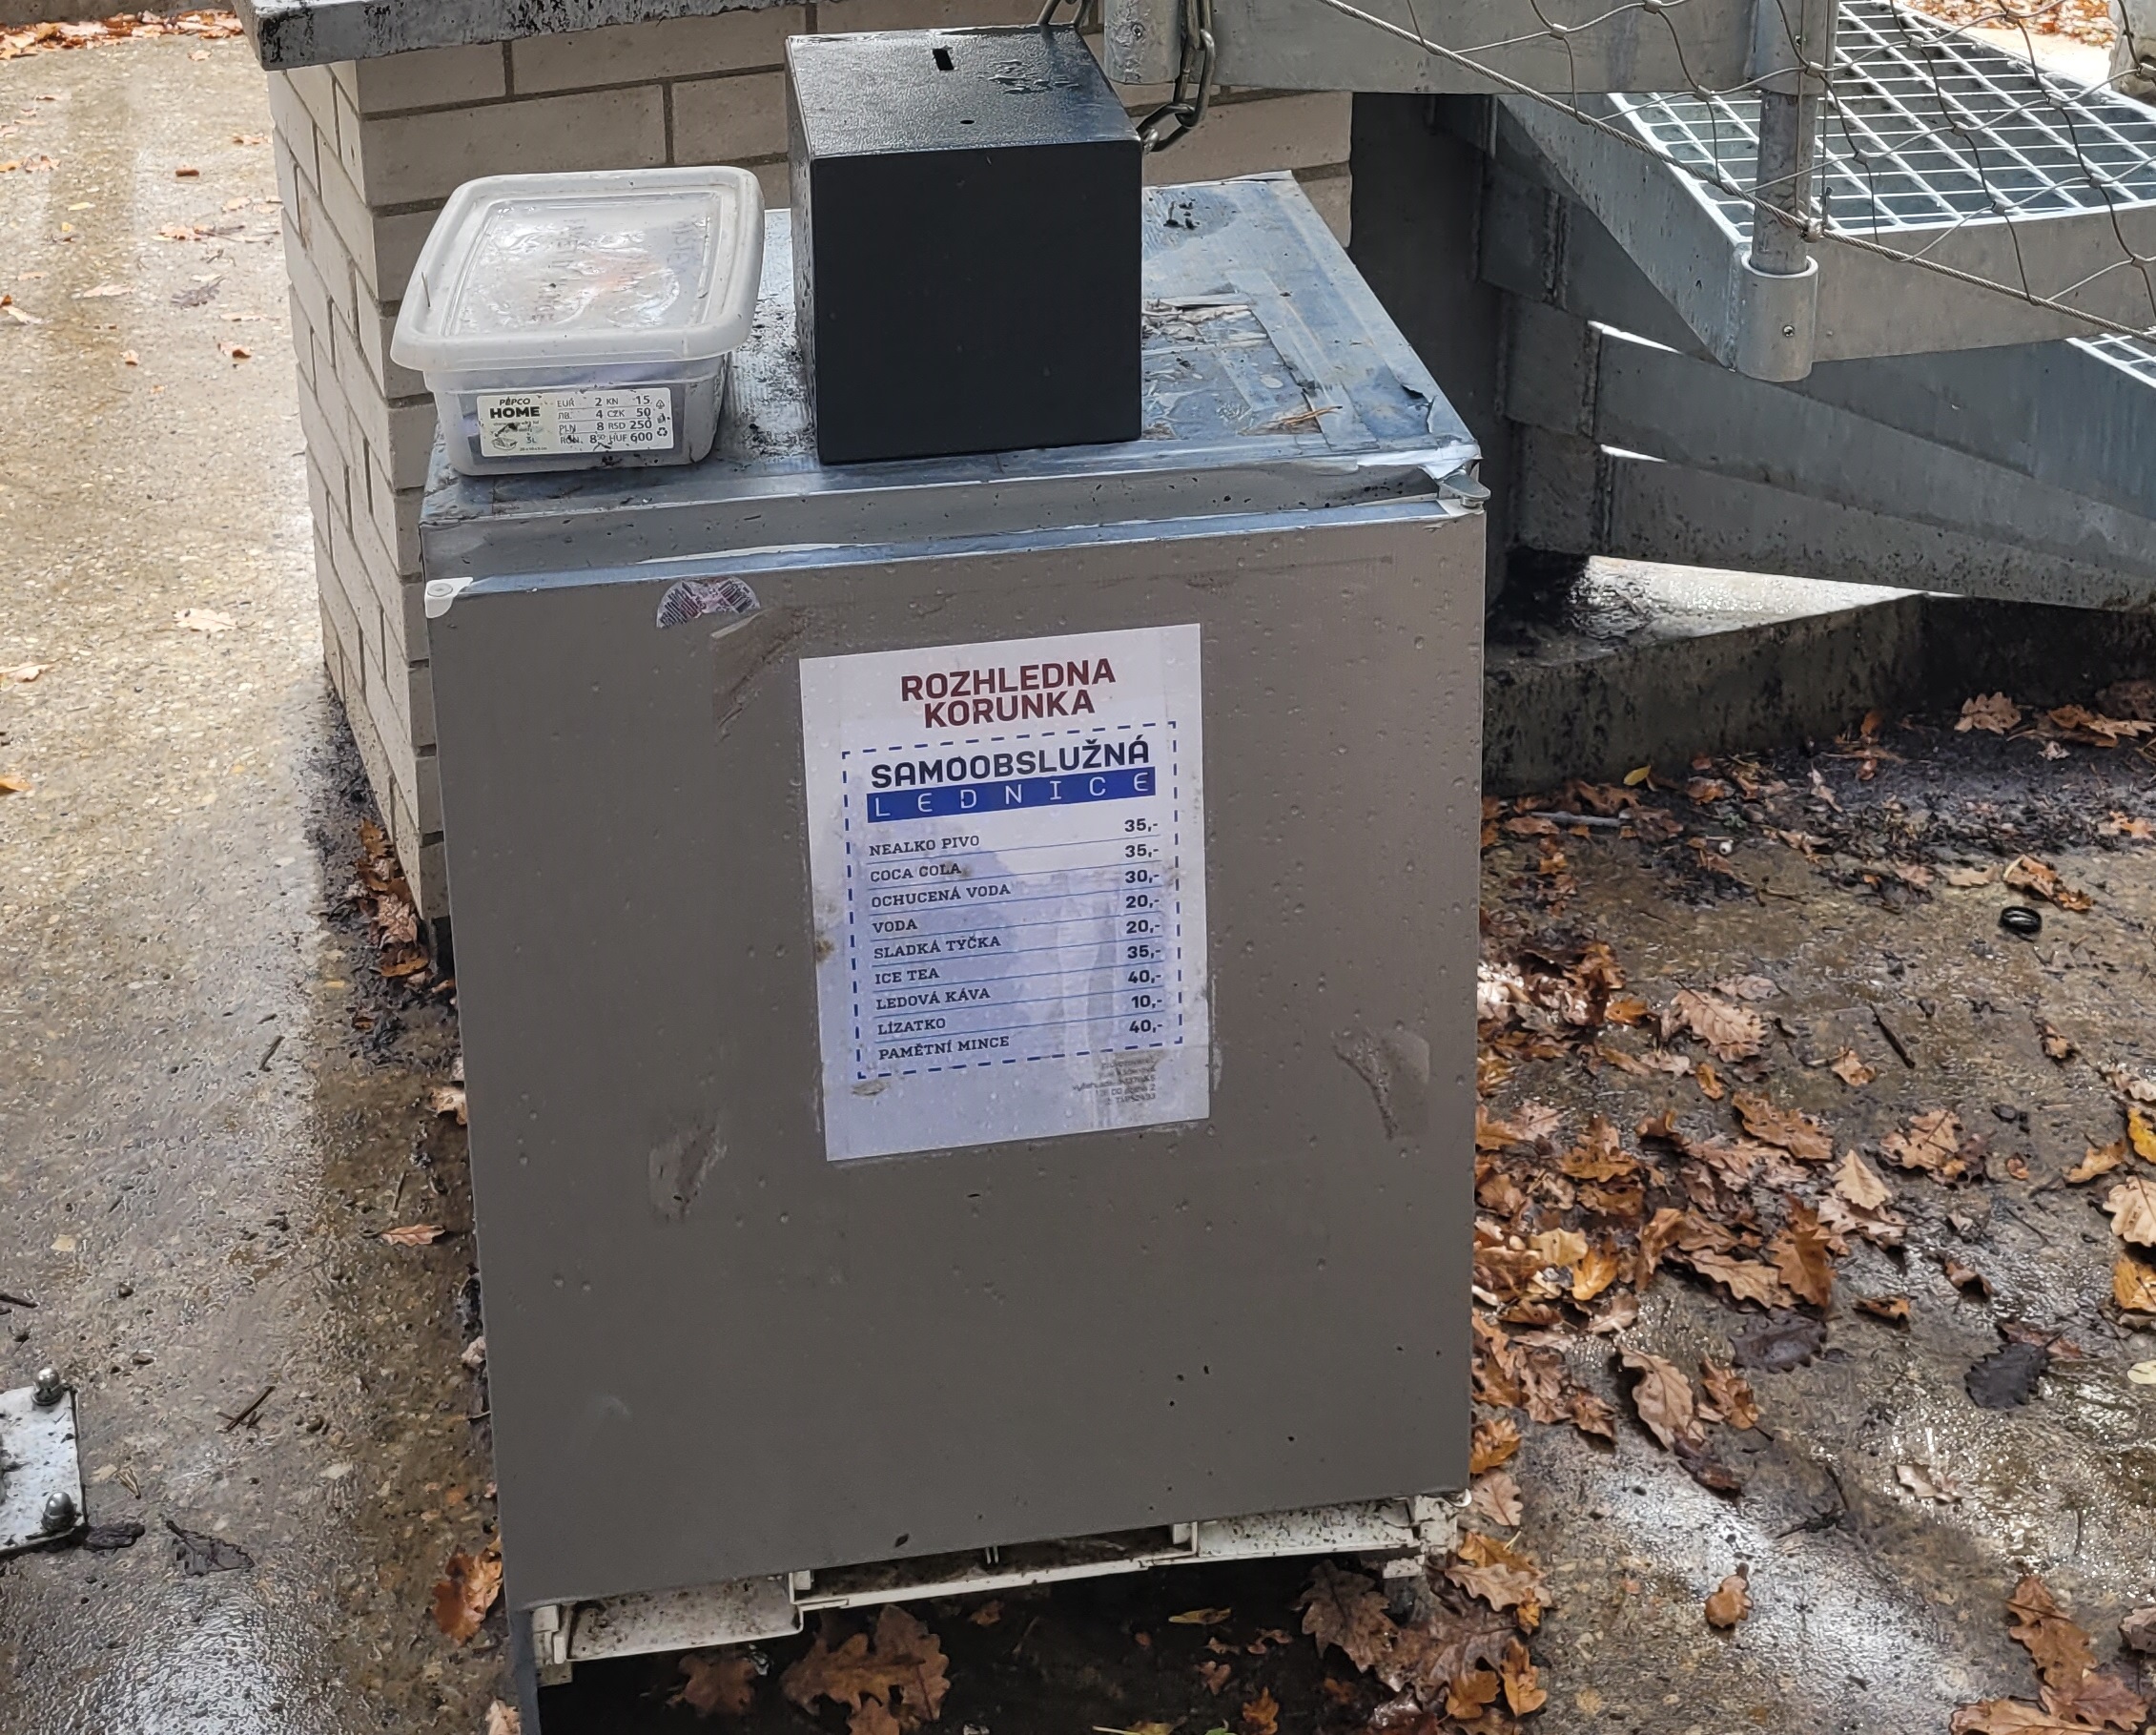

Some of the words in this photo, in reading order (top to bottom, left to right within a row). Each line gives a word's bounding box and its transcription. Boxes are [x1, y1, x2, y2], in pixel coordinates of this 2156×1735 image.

[489, 406, 541, 419] HOME
[500, 397, 531, 406] PEPCO
[557, 399, 575, 407] EUR
[595, 397, 603, 407] 2
[596, 409, 604, 419] 4
[607, 409, 626, 418] CZK
[636, 407, 651, 417] 50
[636, 395, 650, 404] 15
[559, 424, 576, 433] PLN
[597, 422, 605, 431] 8
[608, 422, 626, 430] RSD
[629, 420, 652, 429] 250
[609, 433, 627, 443] HUF
[630, 432, 653, 443] 600
[901, 658, 1116, 701] ROZHLEDNA
[924, 689, 1095, 729] KORUNKA
[871, 734, 1149, 789] SAMOOBSLUŽNÁ
[874, 772, 1150, 817] LEDNICE
[869, 839, 936, 857] NEALKO
[941, 835, 980, 849] PIVO
[1124, 817, 1158, 832] 35,-
[870, 868, 914, 882] COCA
[918, 863, 961, 878] COLA
[1125, 843, 1159, 858] 35,-
[872, 886, 961, 908] OCHUCENÁ
[966, 883, 1011, 898] VODA
[1125, 869, 1160, 884] 30,-
[872, 919, 918, 934] VODA
[1125, 895, 1160, 909] 20,-
[873, 940, 941, 960] SLADKÁ
[946, 936, 1002, 951] TYČKA
[1126, 919, 1160, 934] 20,-
[874, 972, 902, 984] ICE
[907, 967, 940, 981] TEA
[1127, 944, 1161, 959] 35,-
[875, 991, 941, 1010] LEDOVÁ
[945, 987, 991, 1002] KÁVA
[1127, 969, 1161, 983] 40,-
[877, 1018, 946, 1035] LÍZATKO
[1131, 995, 1162, 1009] 10,-
[878, 1040, 954, 1061] PAMĚTNÍ
[957, 1036, 1010, 1052] MINCE
[1129, 1019, 1163, 1034] 40,-
